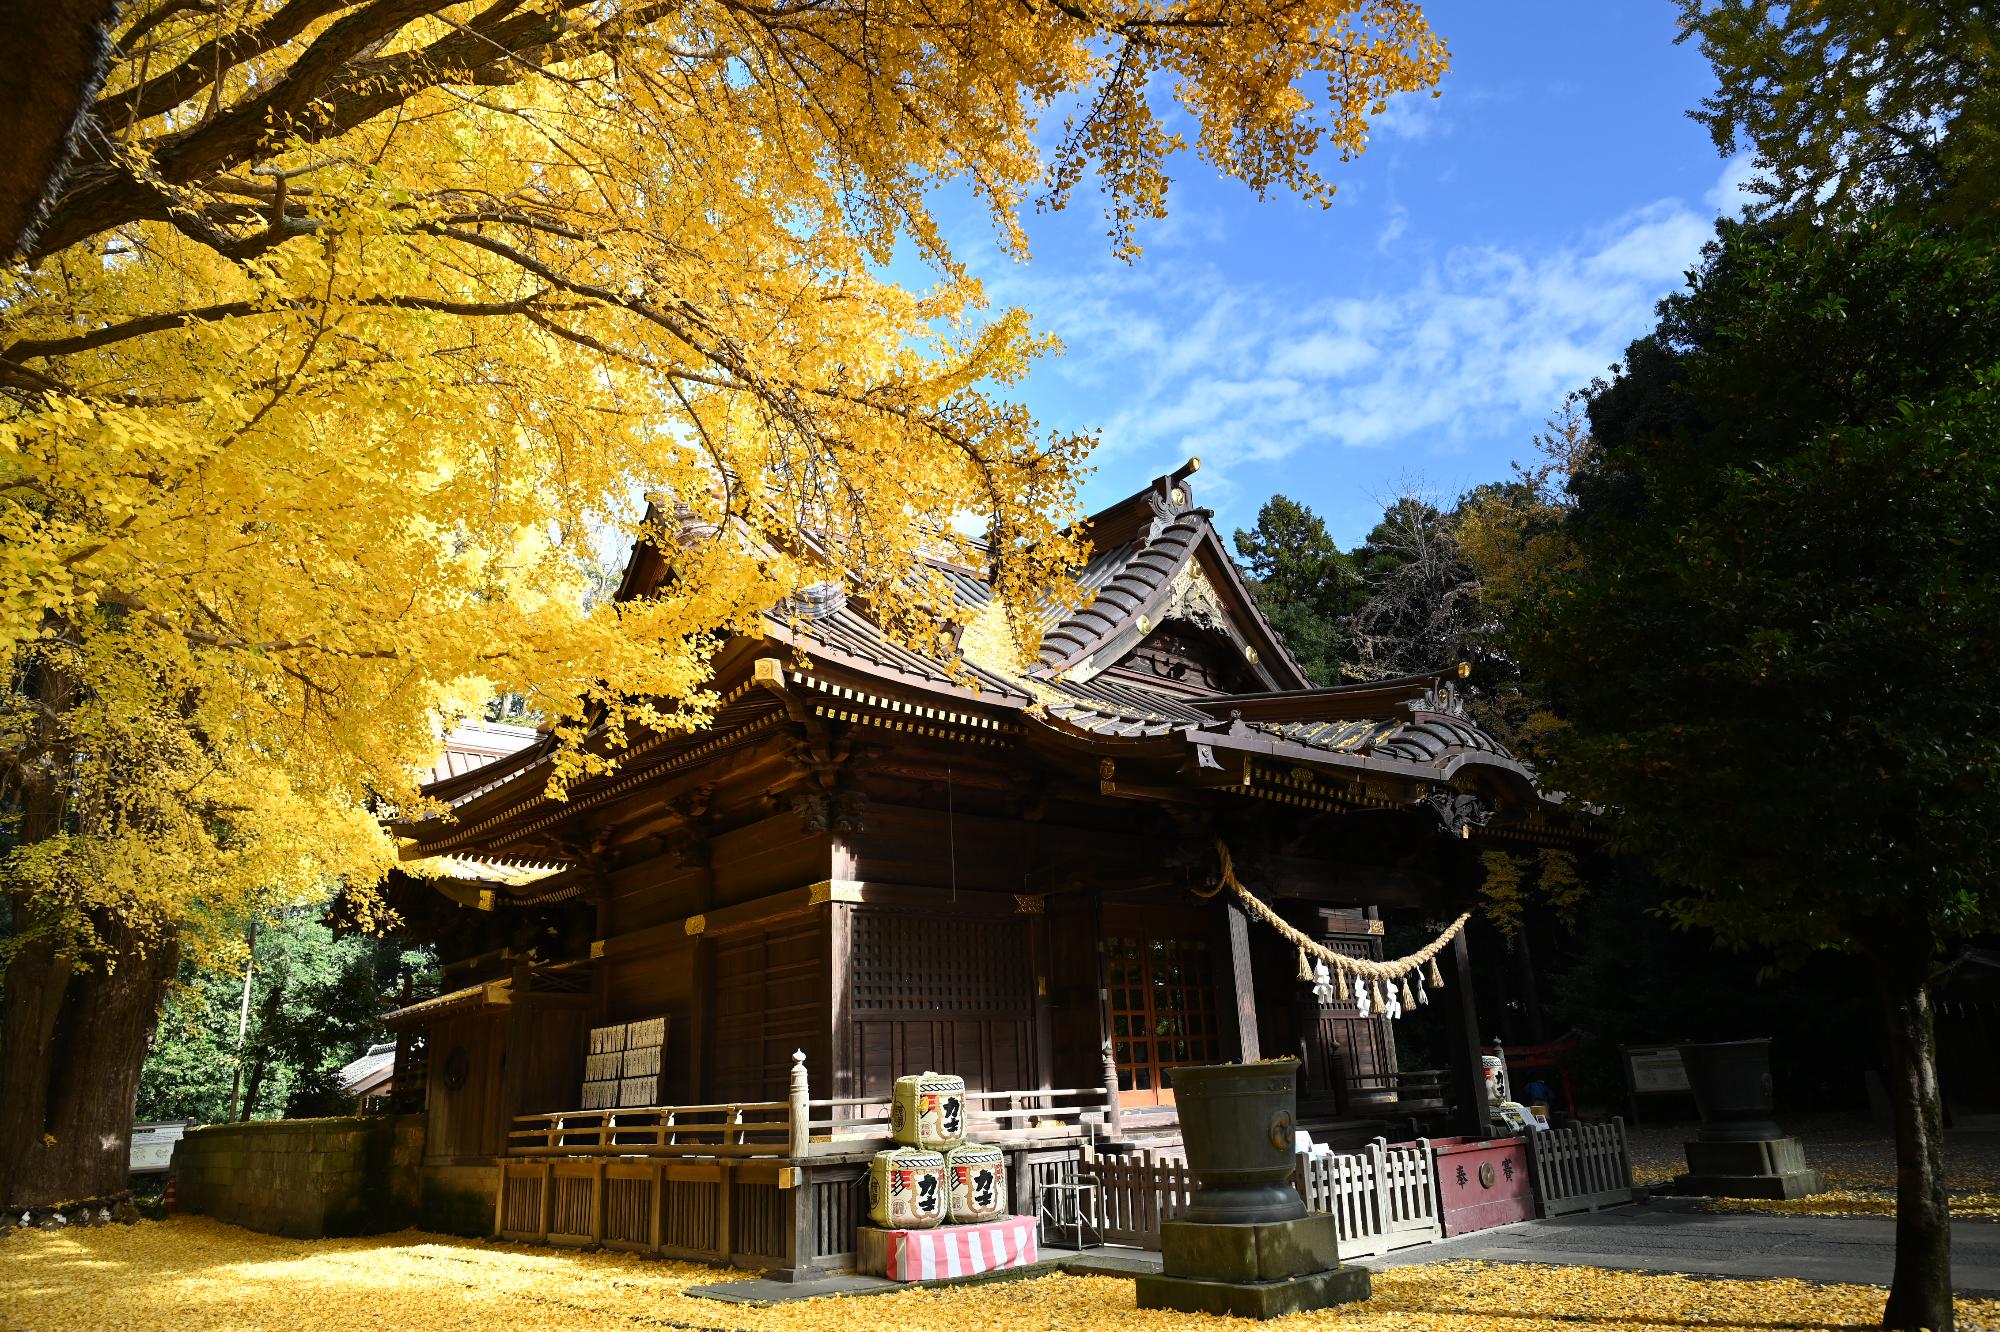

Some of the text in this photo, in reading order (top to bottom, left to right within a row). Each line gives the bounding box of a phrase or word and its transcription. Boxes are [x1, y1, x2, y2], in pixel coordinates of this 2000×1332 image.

[943, 1096, 960, 1133] 力士
[918, 1173, 938, 1212] 力士
[974, 1169, 994, 1207] 力士
[1456, 1164, 1468, 1190] 奉
